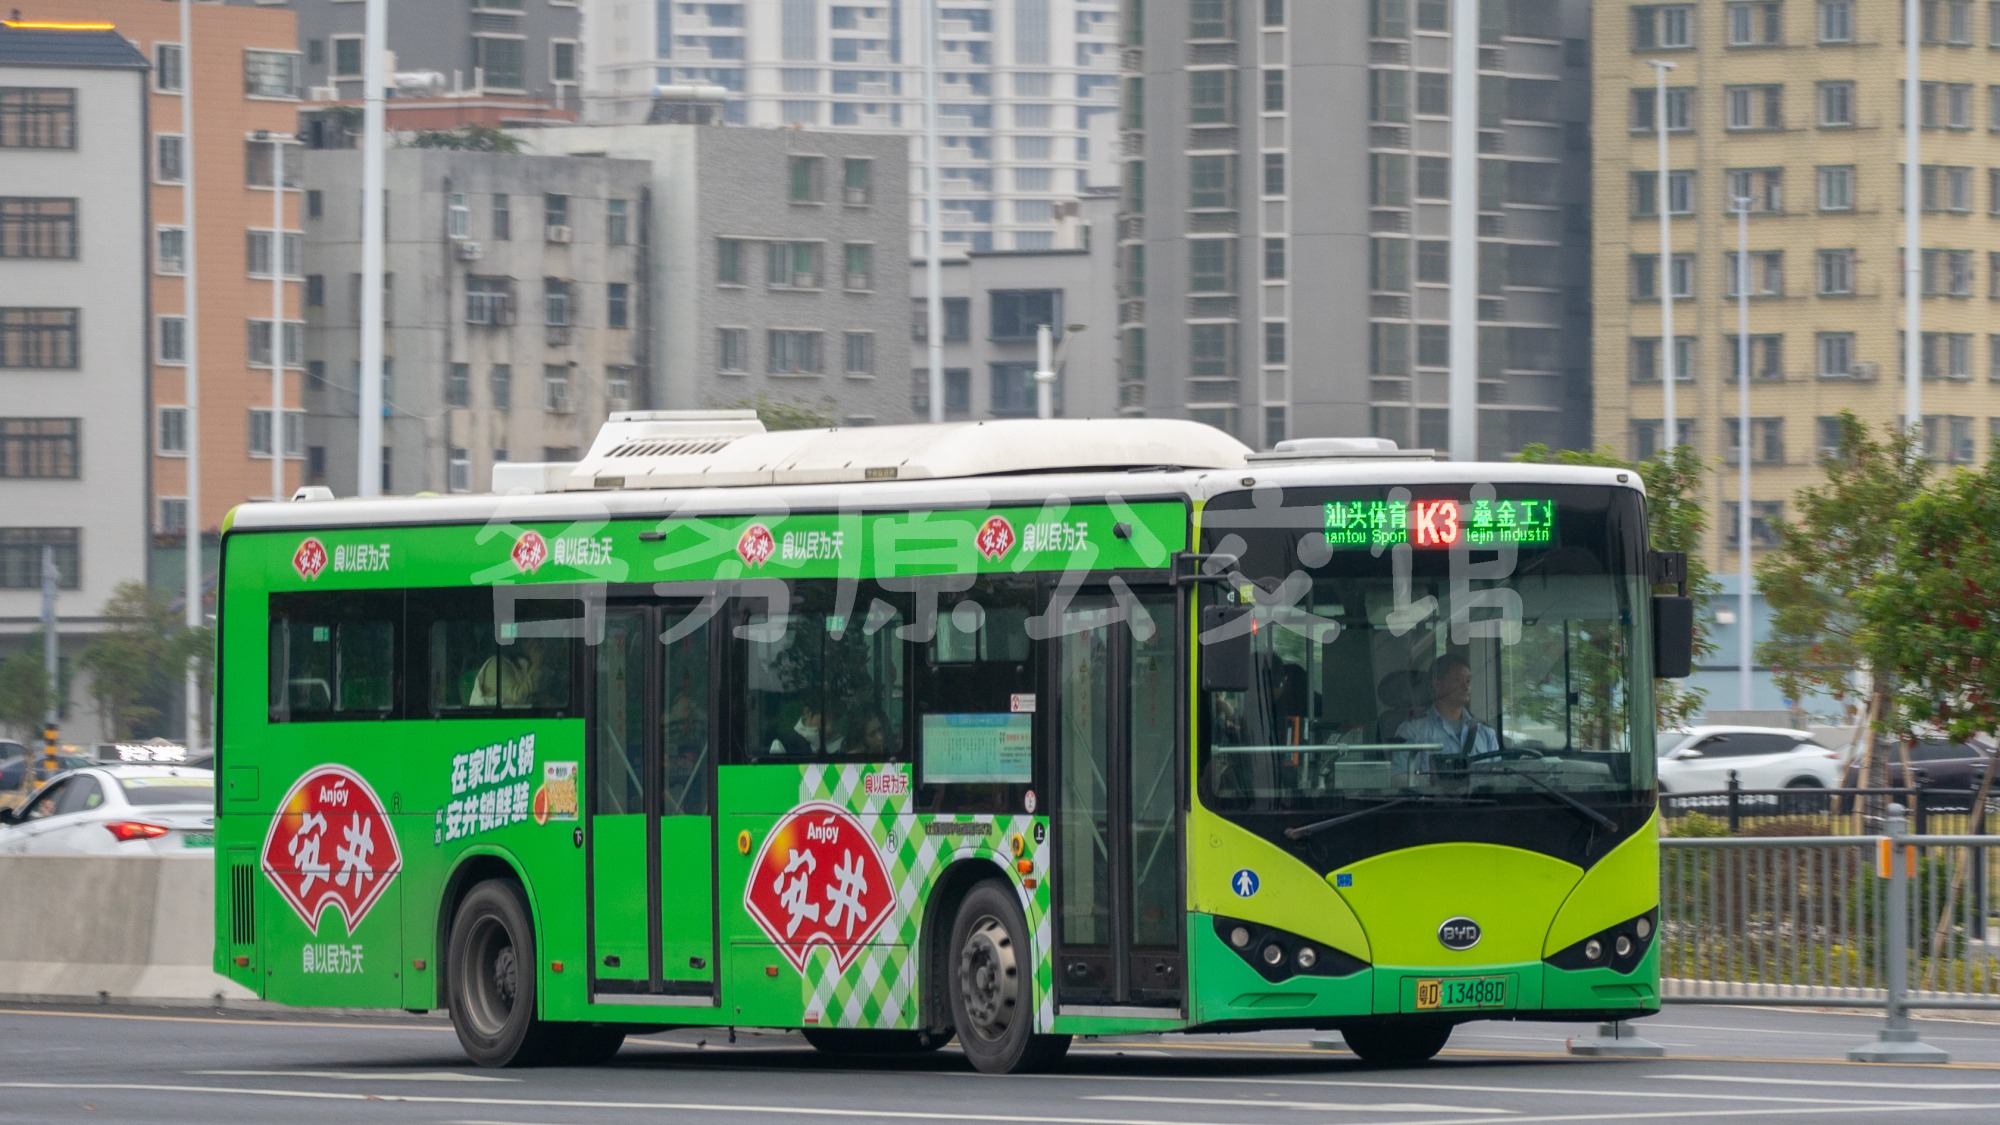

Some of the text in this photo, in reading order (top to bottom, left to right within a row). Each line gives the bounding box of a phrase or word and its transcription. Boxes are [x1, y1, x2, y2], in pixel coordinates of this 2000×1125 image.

[1326, 501, 1407, 529] 汕头体育
[1417, 502, 1457, 544] K3
[554, 537, 613, 565] 食以民为天
[782, 530, 844, 560] 食以民为天
[1023, 522, 1088, 552] 食以民为天
[334, 544, 390, 572] 食以民为天
[451, 733, 535, 795] 在家吃火锅
[319, 779, 349, 807] Anjoy
[865, 774, 908, 794] 食以民为天
[445, 781, 530, 841] 安井锁鲜装
[807, 815, 839, 844] Anjoy
[1035, 826, 1044, 840] 上
[288, 810, 374, 899] 安井
[773, 848, 867, 940] 安井
[1444, 926, 1476, 940] BYD
[303, 944, 364, 974] 食以民为天
